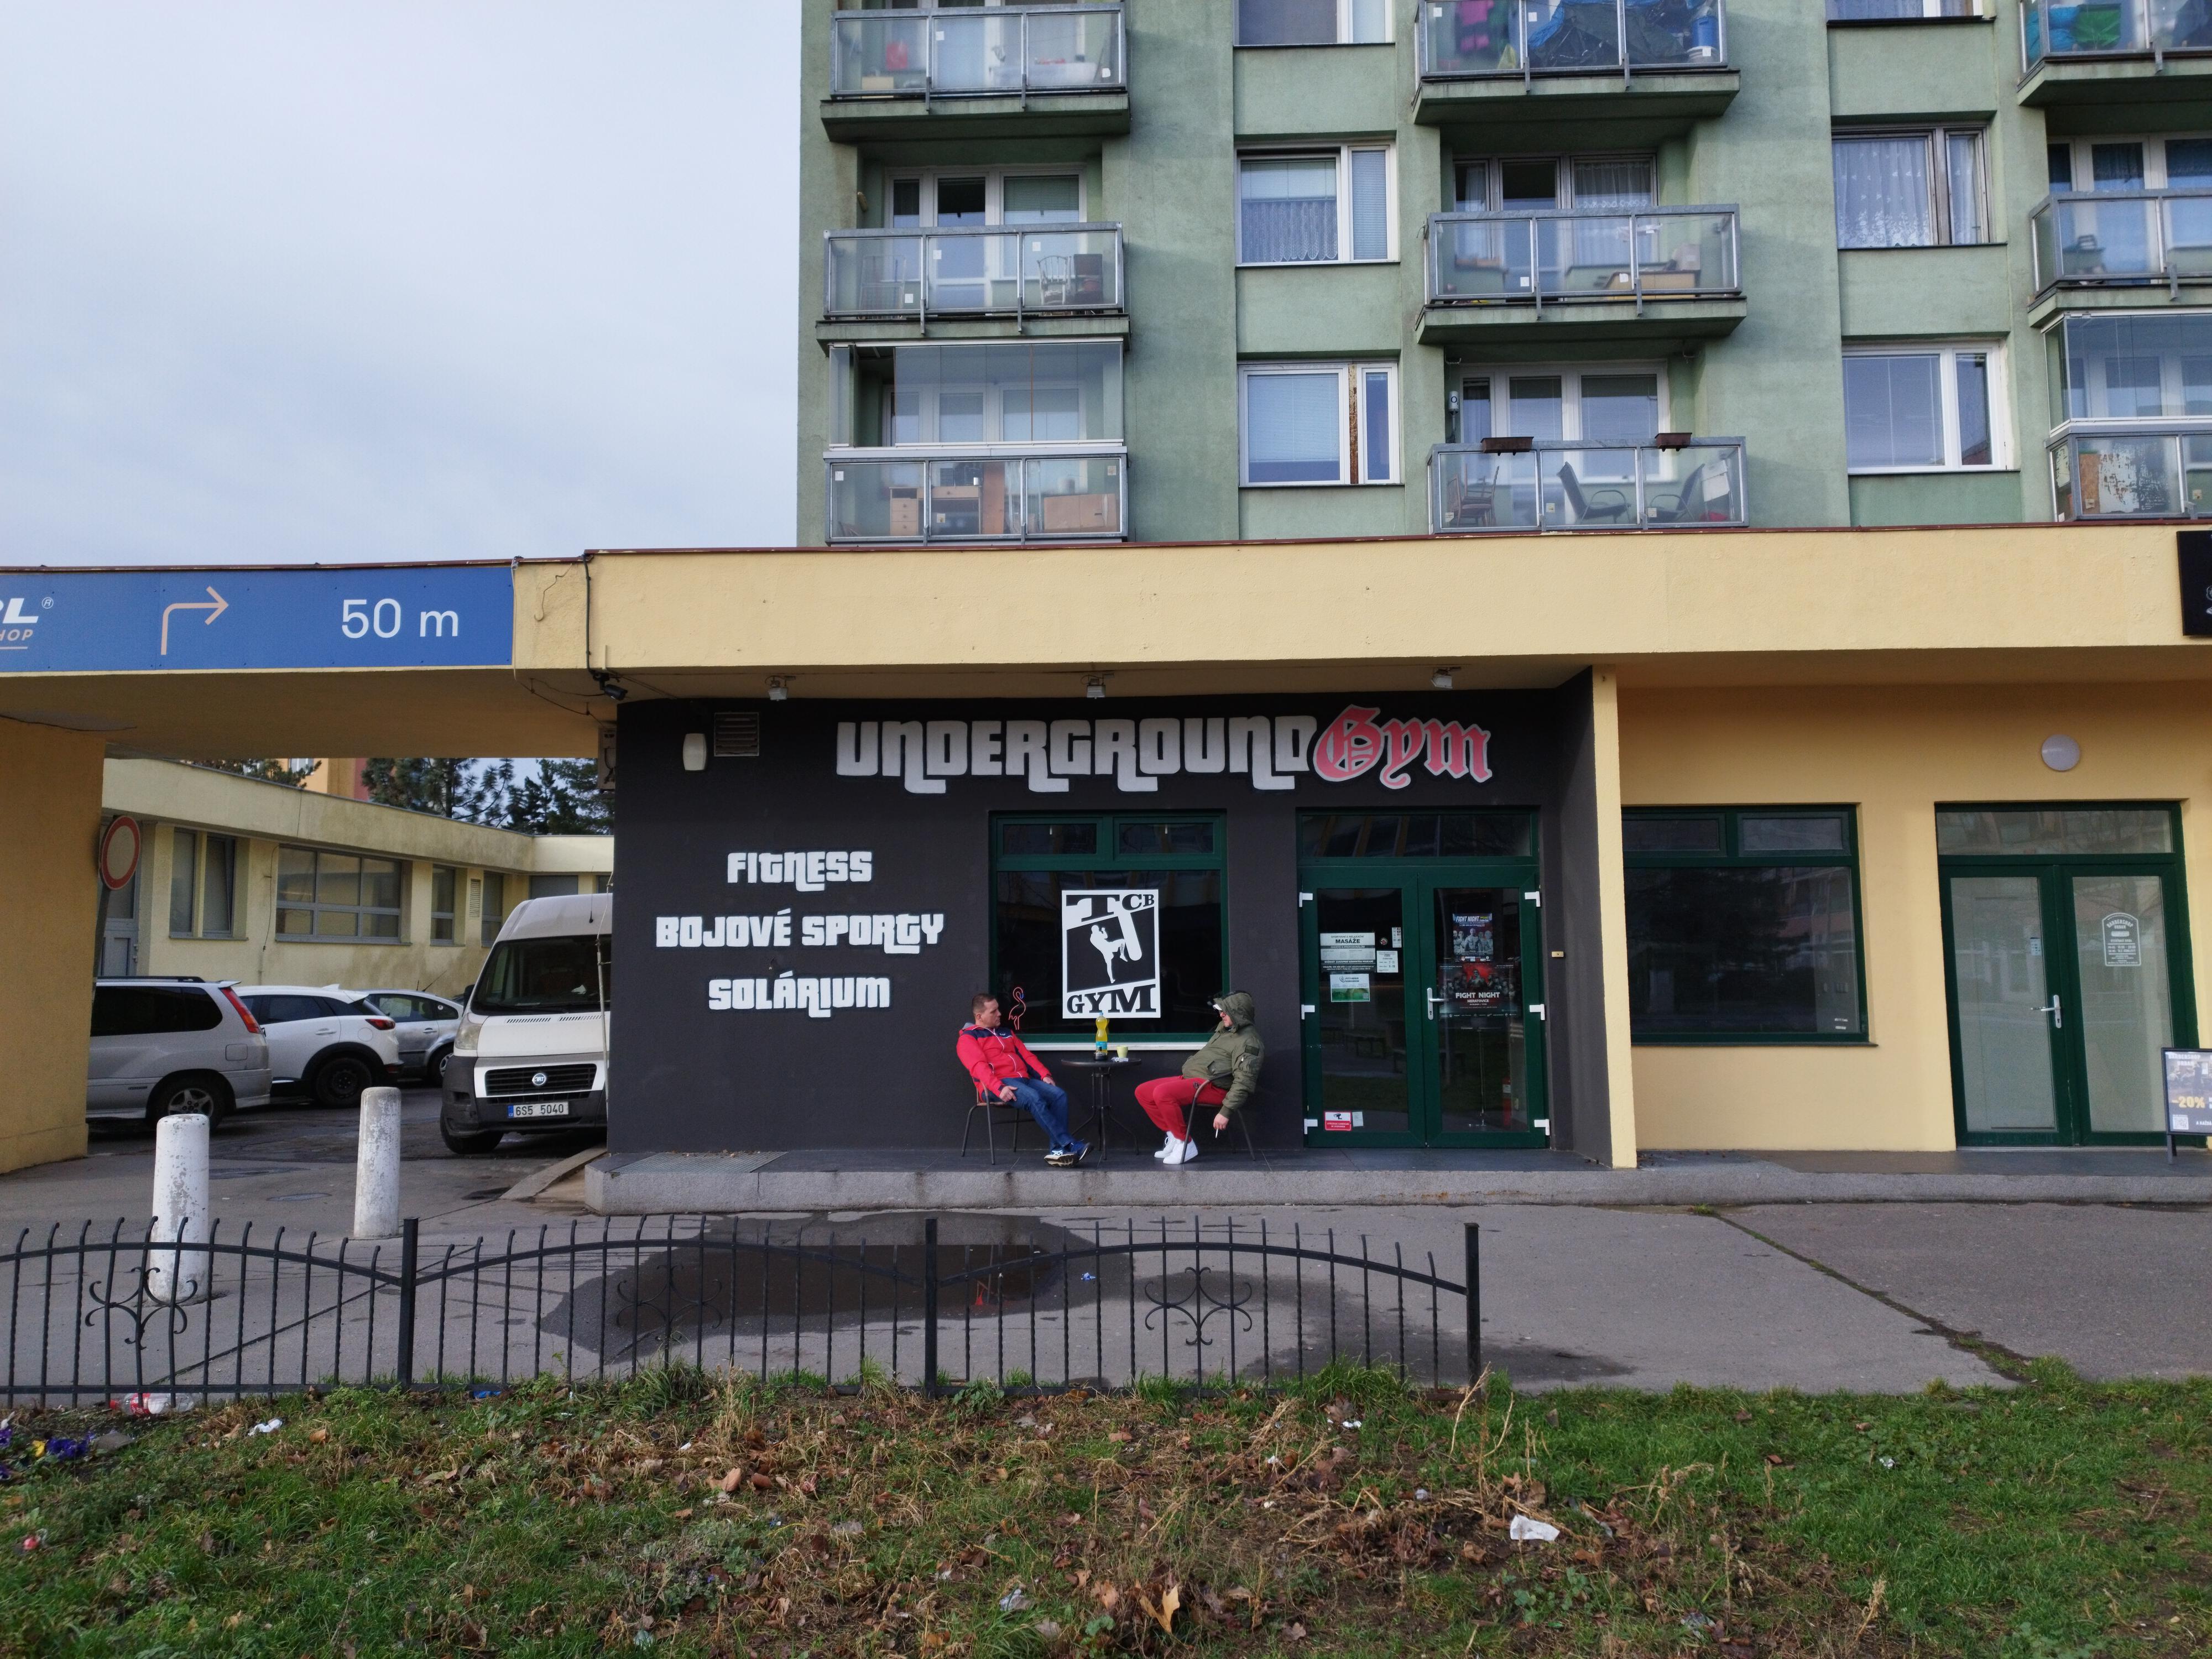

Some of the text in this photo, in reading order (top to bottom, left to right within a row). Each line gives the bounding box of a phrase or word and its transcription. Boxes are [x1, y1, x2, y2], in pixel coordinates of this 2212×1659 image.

[342, 598, 458, 639] 50 m
[836, 703, 1493, 794] UNDERGROUND Gym
[727, 851, 873, 892] FITNESS
[1066, 894, 1155, 922] TCB
[656, 907, 945, 954] BOJOVÉ SPORTY
[708, 970, 890, 1018] SOLÁRIUM
[1067, 984, 1157, 1014] GYM
[515, 1104, 564, 1116] 6S5 5040
[2172, 1096, 2205, 1108] -20%
